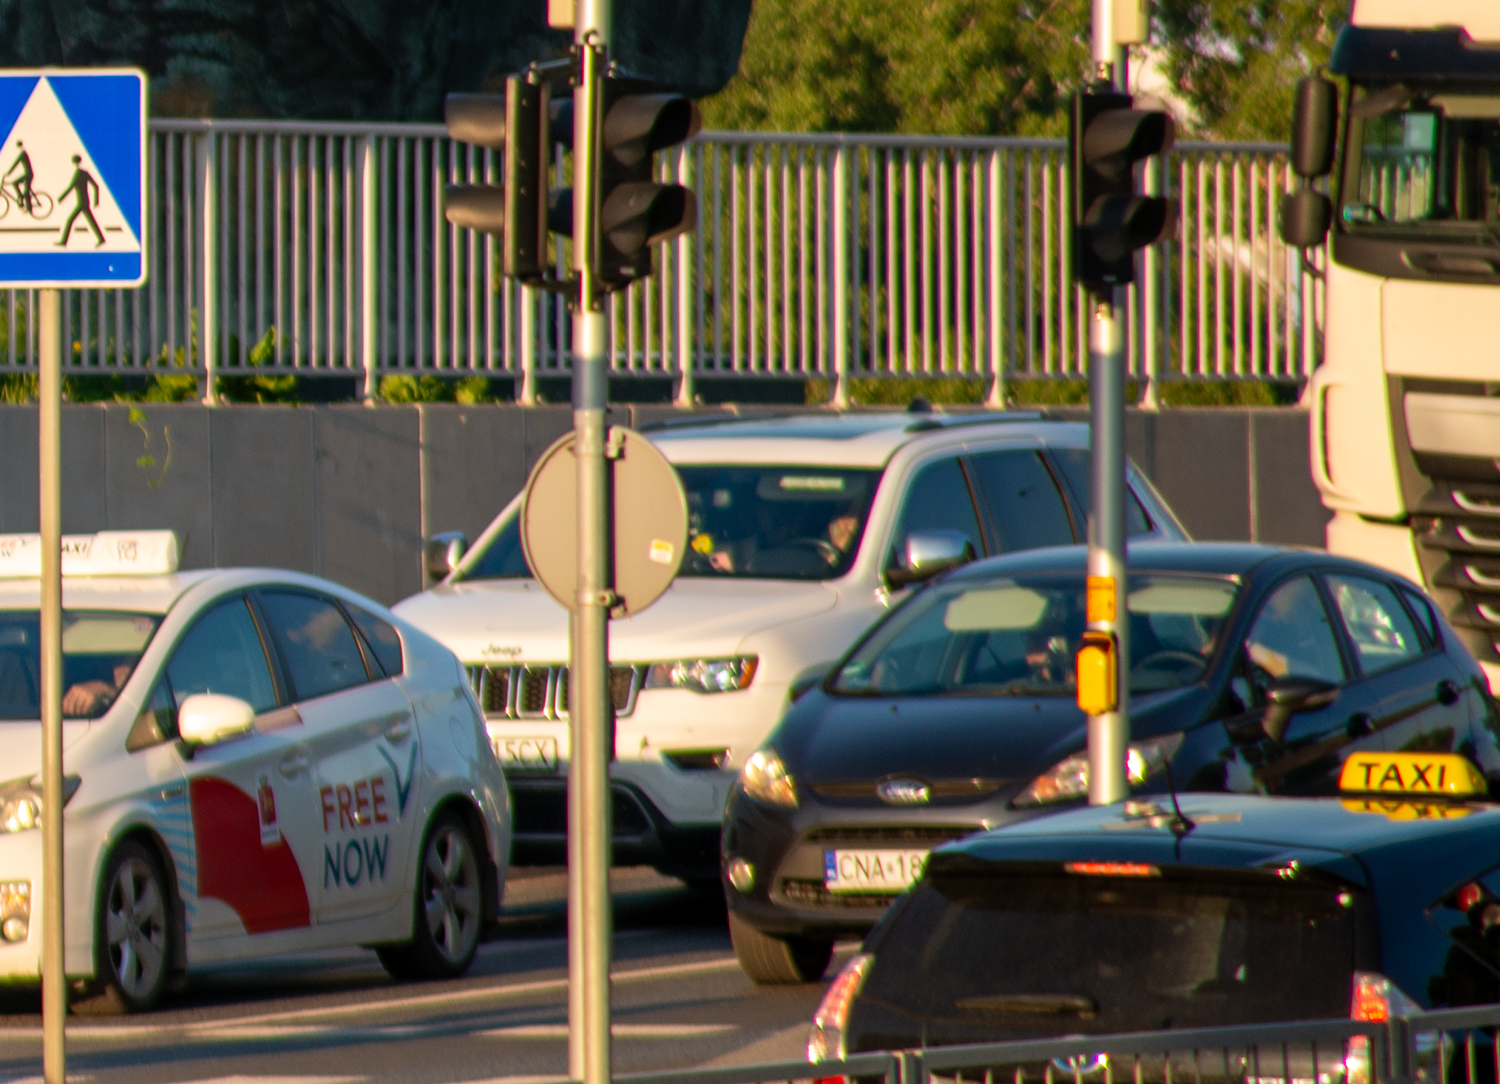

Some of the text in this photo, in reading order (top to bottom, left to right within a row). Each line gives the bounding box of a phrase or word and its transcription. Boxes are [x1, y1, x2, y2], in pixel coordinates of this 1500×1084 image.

[62, 541, 88, 555] AXI
[482, 643, 522, 663] Jeep
[1358, 762, 1446, 789] TAXI
[319, 776, 389, 833] FREE
[324, 833, 389, 890] NOW
[840, 855, 887, 883] CNA
